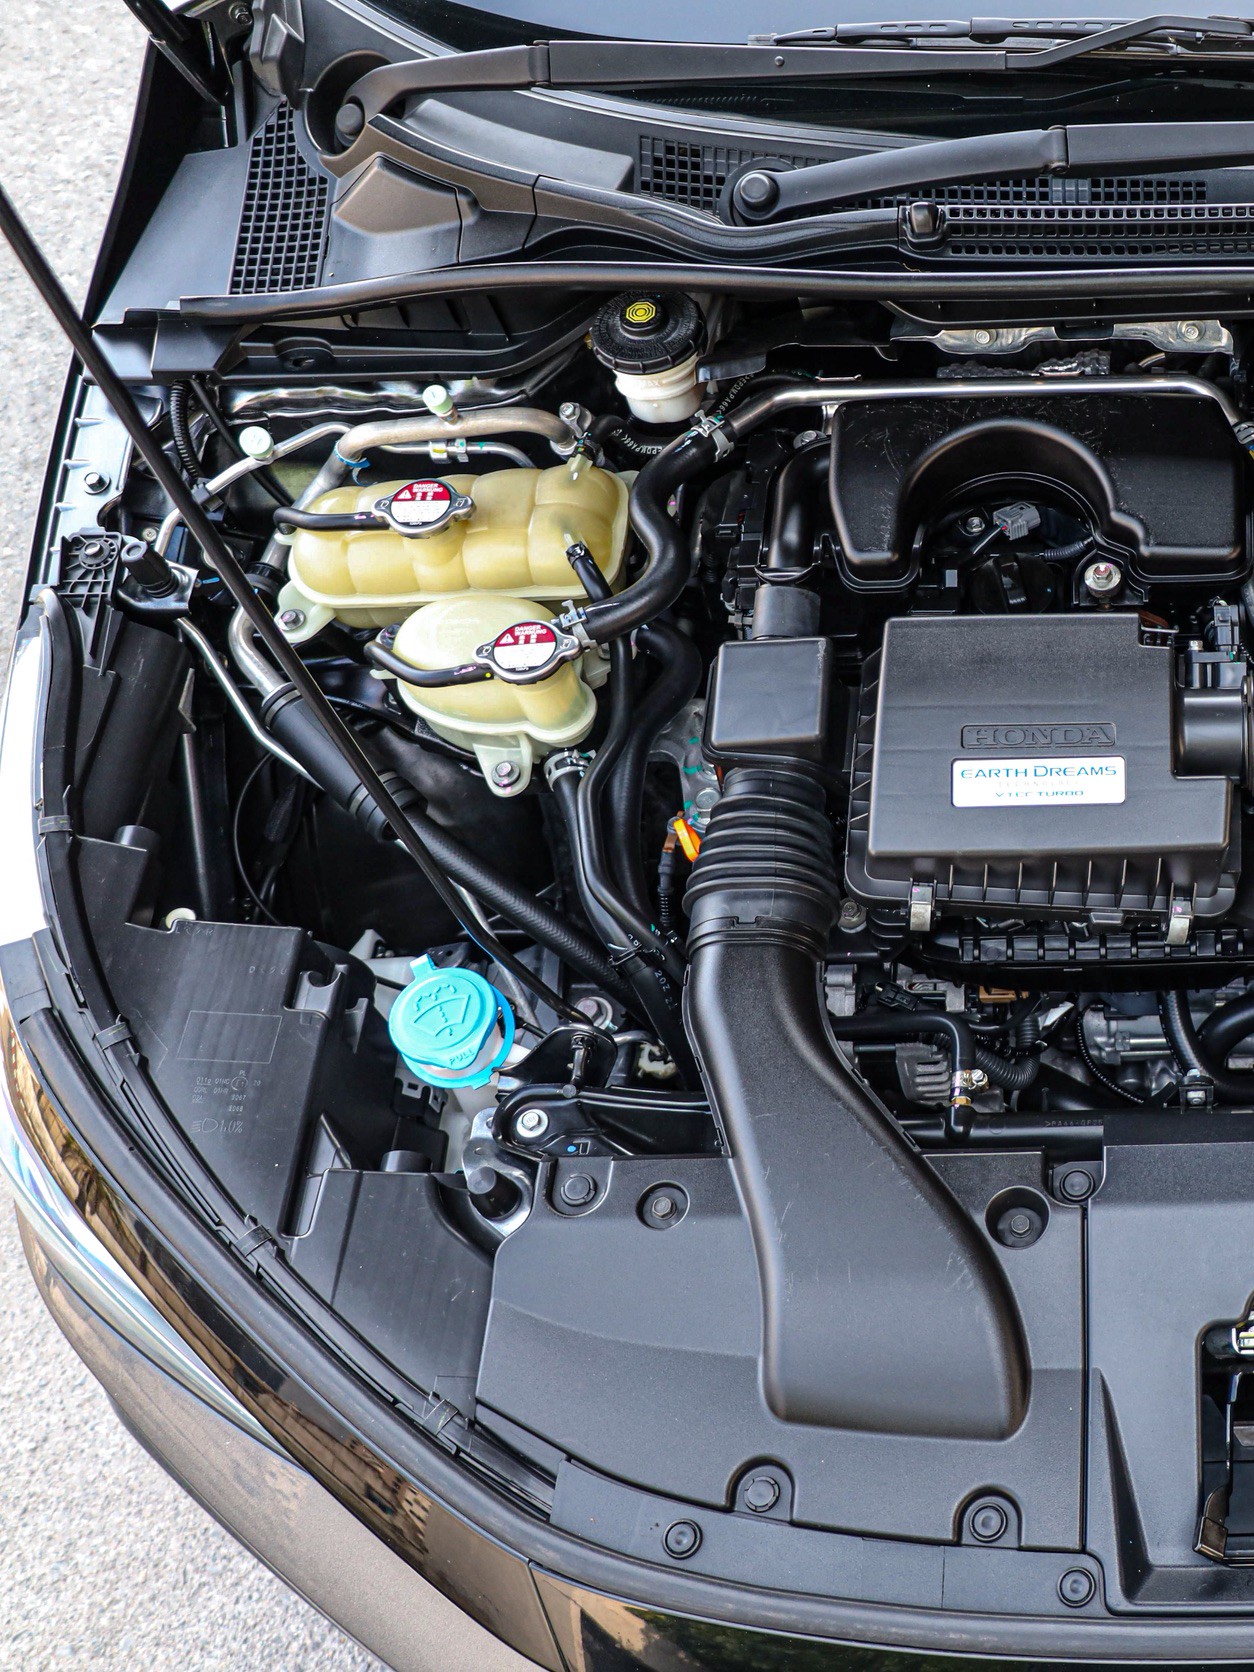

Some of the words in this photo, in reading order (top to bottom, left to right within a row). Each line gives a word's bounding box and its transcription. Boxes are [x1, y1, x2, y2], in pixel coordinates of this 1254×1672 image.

[967, 726, 1114, 746] HONDA
[960, 767, 1029, 779] EARTH
[1033, 765, 1118, 778] DREAMS
[449, 1049, 475, 1066] PULL
